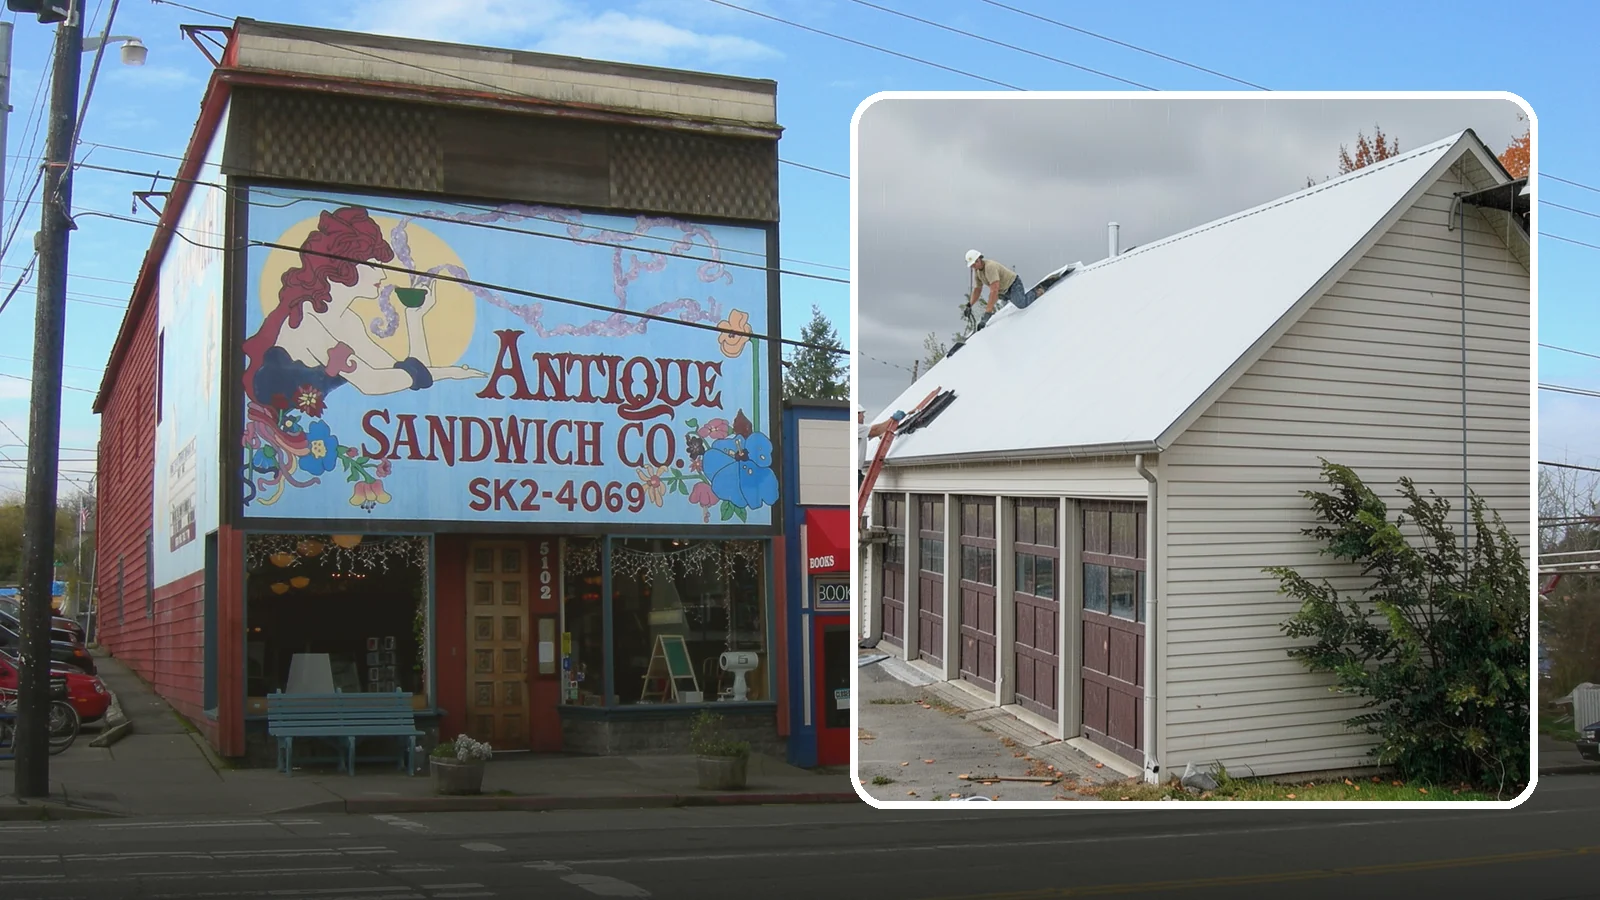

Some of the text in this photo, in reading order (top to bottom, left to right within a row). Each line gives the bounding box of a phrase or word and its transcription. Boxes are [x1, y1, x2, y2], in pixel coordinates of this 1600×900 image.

[475, 328, 724, 421] ANTIQUE
[361, 408, 685, 468] SANDWICH CO.
[468, 476, 646, 513] SK2-4069
[540, 541, 551, 600] 5102
[809, 555, 835, 569] BOOKS
